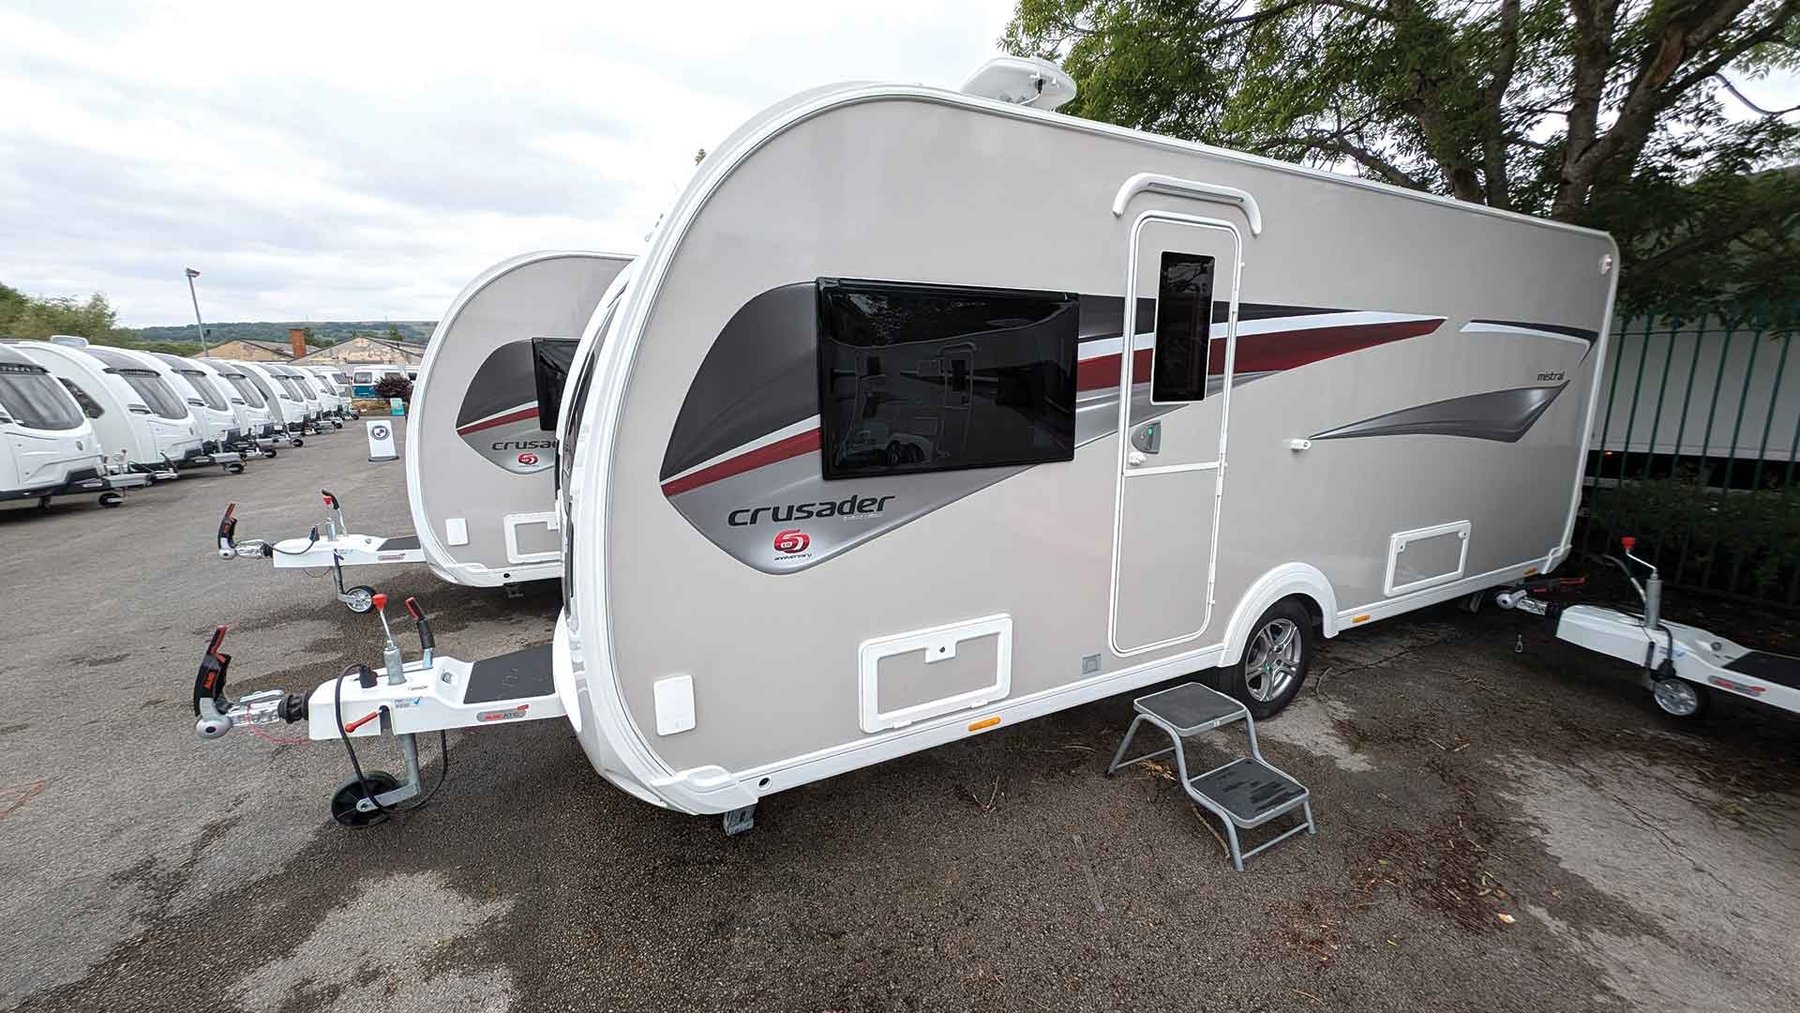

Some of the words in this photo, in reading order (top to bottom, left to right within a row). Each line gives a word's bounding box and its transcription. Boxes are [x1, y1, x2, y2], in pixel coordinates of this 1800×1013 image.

[1537, 370, 1565, 381] mistral
[727, 494, 896, 527] crusader
[774, 553, 812, 561] anniversary
